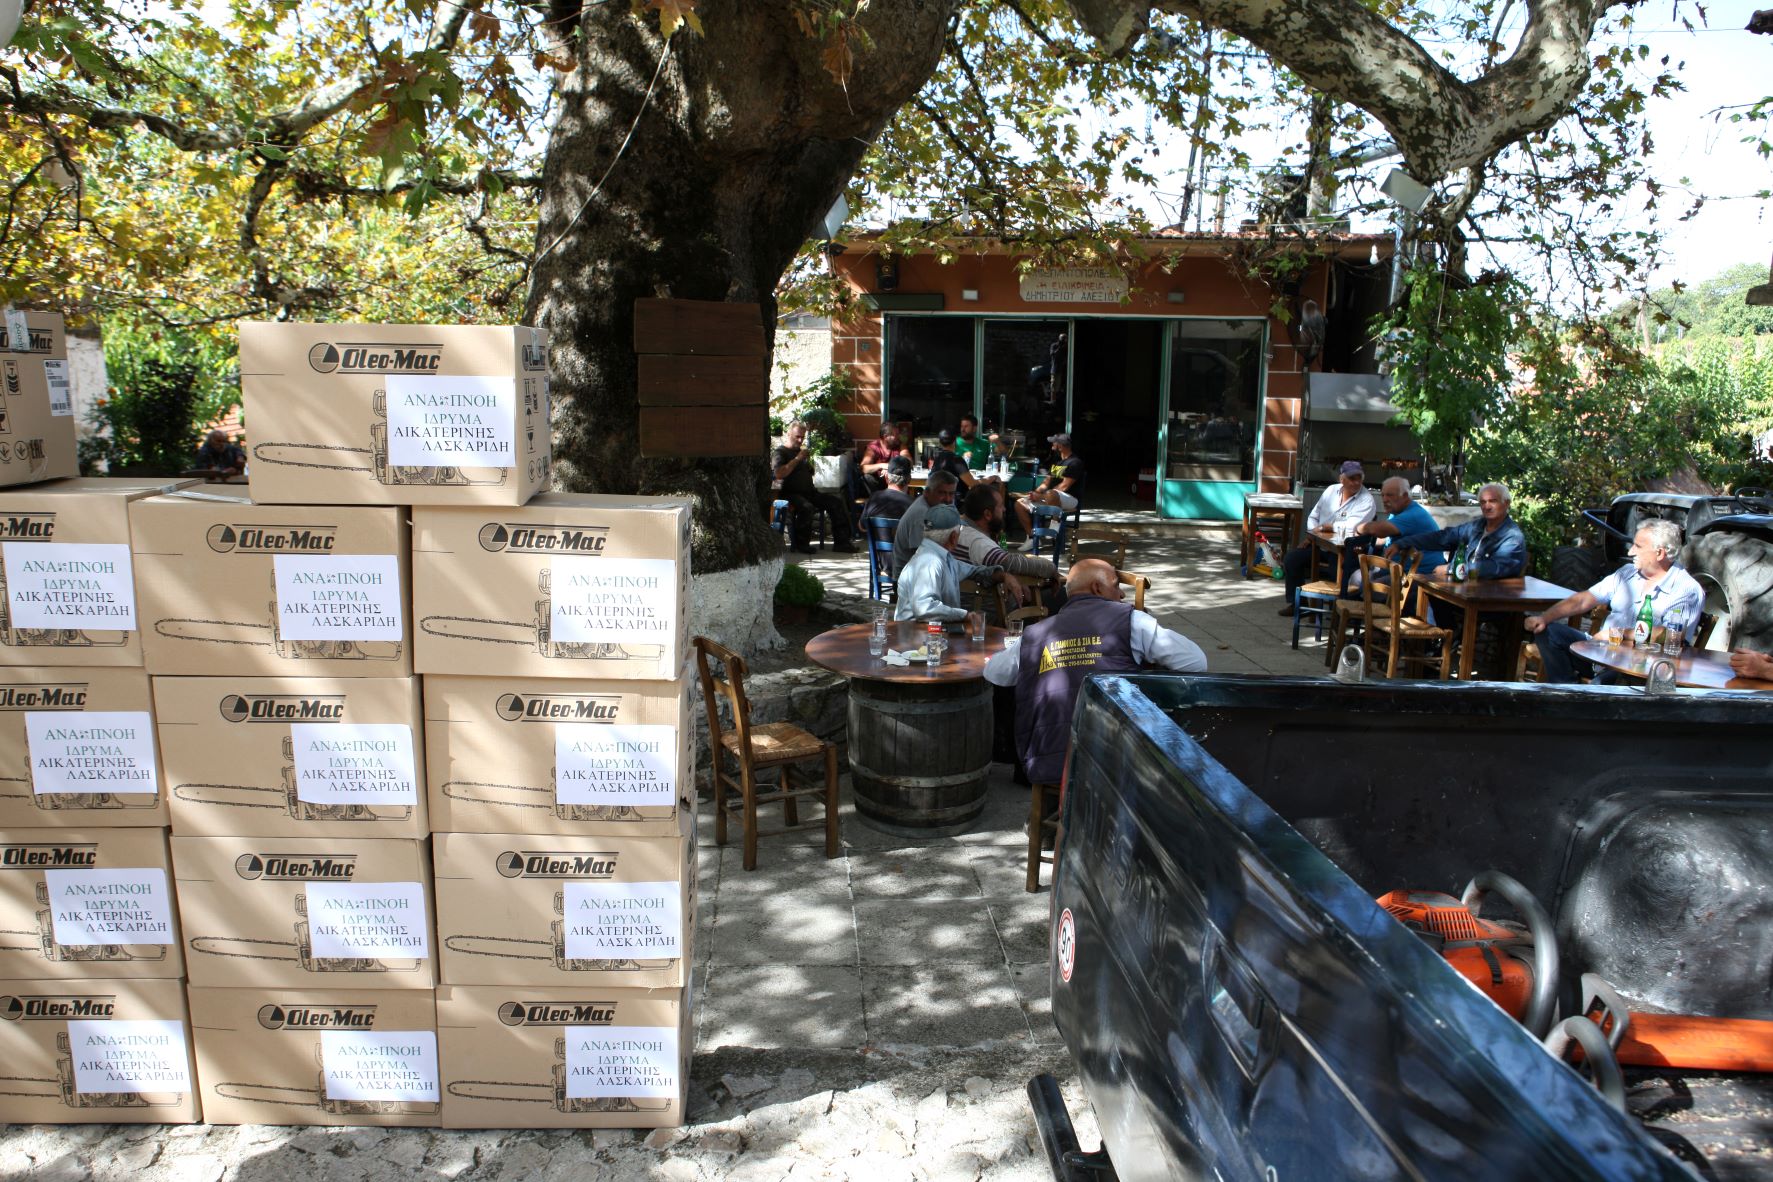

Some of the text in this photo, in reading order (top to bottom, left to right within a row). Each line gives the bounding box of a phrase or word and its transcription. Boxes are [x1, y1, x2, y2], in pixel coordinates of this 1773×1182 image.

[341, 349, 441, 370] Oleo-Mac
[424, 414, 482, 425] ΙΔΡΥΜΑ
[394, 426, 495, 438] ΑΙΚΑΤΕΡΙΝΗΣ
[422, 440, 509, 452] ΛΑΣΚΑΡΙΔΗ
[238, 530, 335, 550] Oleo-Mac
[510, 530, 607, 551] Oleo-Mac
[44, 579, 101, 590] ΙΔΡΥΜΑ
[15, 592, 115, 603] ΑΙΚΑΤΕΡΙΝΗΣ
[313, 590, 369, 601] ΙΔΡΥΜΑ
[43, 605, 129, 616] ΛΑΣΚΑΡΙΔΗ
[284, 603, 382, 614] ΑΙΚΑΤΕΡΙΝΗΣ
[311, 616, 396, 627] ΛΑΣΚΑΡΙΔΗ
[250, 700, 344, 719] Oleo-Mac
[525, 699, 619, 719] Oleo-Mac
[66, 745, 123, 756] ΙΔΡΥΜΑ
[38, 758, 136, 769] ΑΙΚΑΤΕΡΙΝΗΣ
[329, 758, 384, 768] ΙΔΡΥΜΑ
[590, 758, 645, 769] ΙΔΡΥΜΑ
[66, 769, 151, 780] ΛΑΣΚΑΡΙΔΗ
[302, 769, 397, 780] ΑΙΚΑΤΕΡΙΝΗΣ
[562, 770, 657, 781] ΑΙΚΑΤΕΡΙΝΗΣ
[329, 781, 411, 792] ΛΑΣΚΑΡΙΔΗ
[588, 782, 670, 793] ΛΑΣΚΑΡΙΔΗ
[3, 849, 97, 866] Oleo-Mac
[265, 859, 356, 878] Oleo-Mac
[524, 857, 617, 875] Oleo-Mac
[84, 899, 140, 910] ΙΔΡΥΜΑ
[58, 911, 153, 921] ΑΙΚΑΤΕΡΙΝΗΣ
[342, 915, 396, 925] ΙΔΡΥΜΑ
[598, 915, 651, 924] ΙΔΡΥΜΑ
[86, 922, 167, 933] ΛΑΣΚΑΡΙΔΗ
[315, 926, 409, 936] ΑΙΚΑΤΕΡΙΝΗΣ
[570, 926, 663, 935] ΑΙΚΑΤΕΡΙΝΗΣ
[342, 937, 422, 947] ΛΑΣΚΑΡΙΔΗ
[596, 937, 676, 947] ΛΑΣΚΑΡΙΔΗ
[25, 1000, 115, 1017] Oleo-Mac
[287, 1009, 375, 1027] Oleo-Mac
[526, 1006, 615, 1024] Oleo-Mac
[599, 1056, 650, 1065] ΙΔΡΥΜΑ
[572, 1066, 661, 1076] ΑΙΚΑΤΕΡΙΝΗΣ
[596, 1076, 673, 1086] ΛΑΣΚΑΡΙΔΗ
